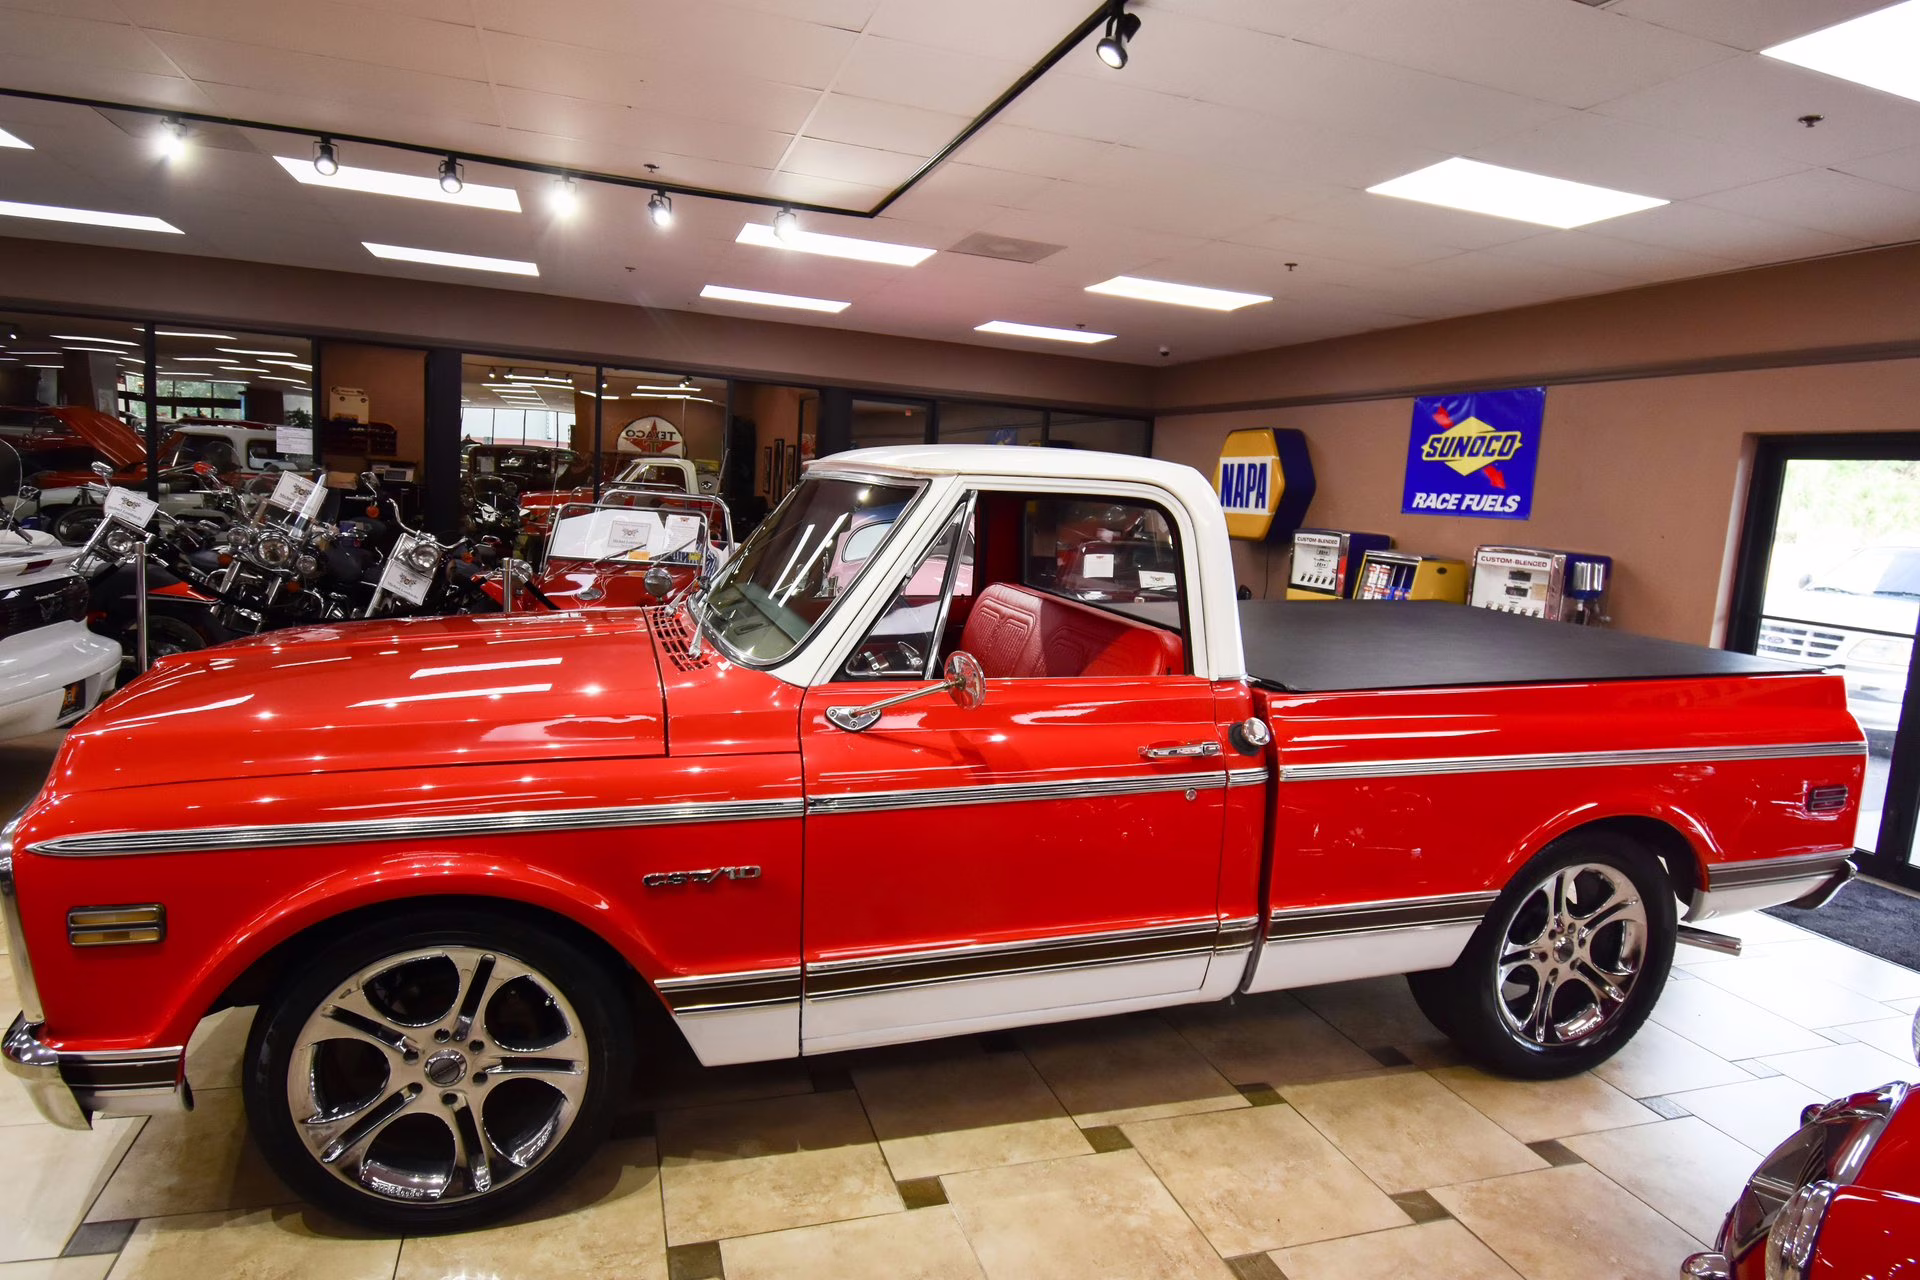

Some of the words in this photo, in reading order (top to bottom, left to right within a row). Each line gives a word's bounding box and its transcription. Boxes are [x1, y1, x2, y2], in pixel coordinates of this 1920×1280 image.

[1425, 434, 1518, 458] SUNOCO
[1221, 463, 1267, 509] NAPA
[1412, 492, 1461, 510] RACE
[1460, 494, 1521, 513] FUELS
